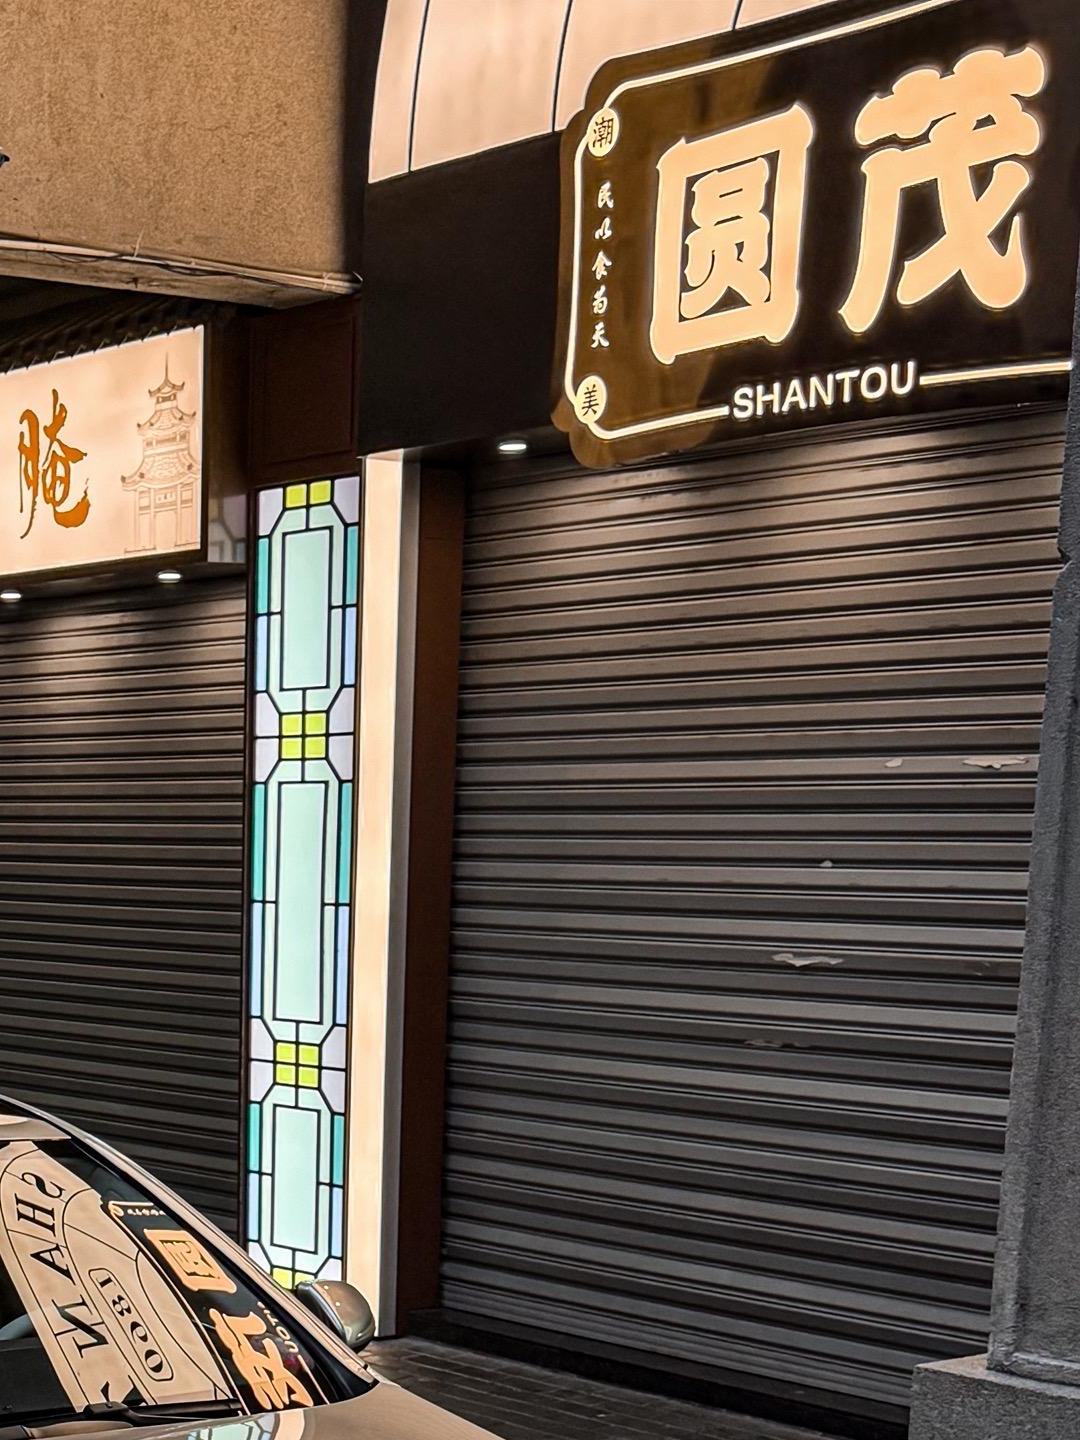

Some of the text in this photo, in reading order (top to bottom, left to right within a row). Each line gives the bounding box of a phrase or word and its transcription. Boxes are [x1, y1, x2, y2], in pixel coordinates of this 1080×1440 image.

[592, 116, 614, 149] 潮
[581, 383, 600, 417] 美
[731, 359, 919, 421] SHANTOU
